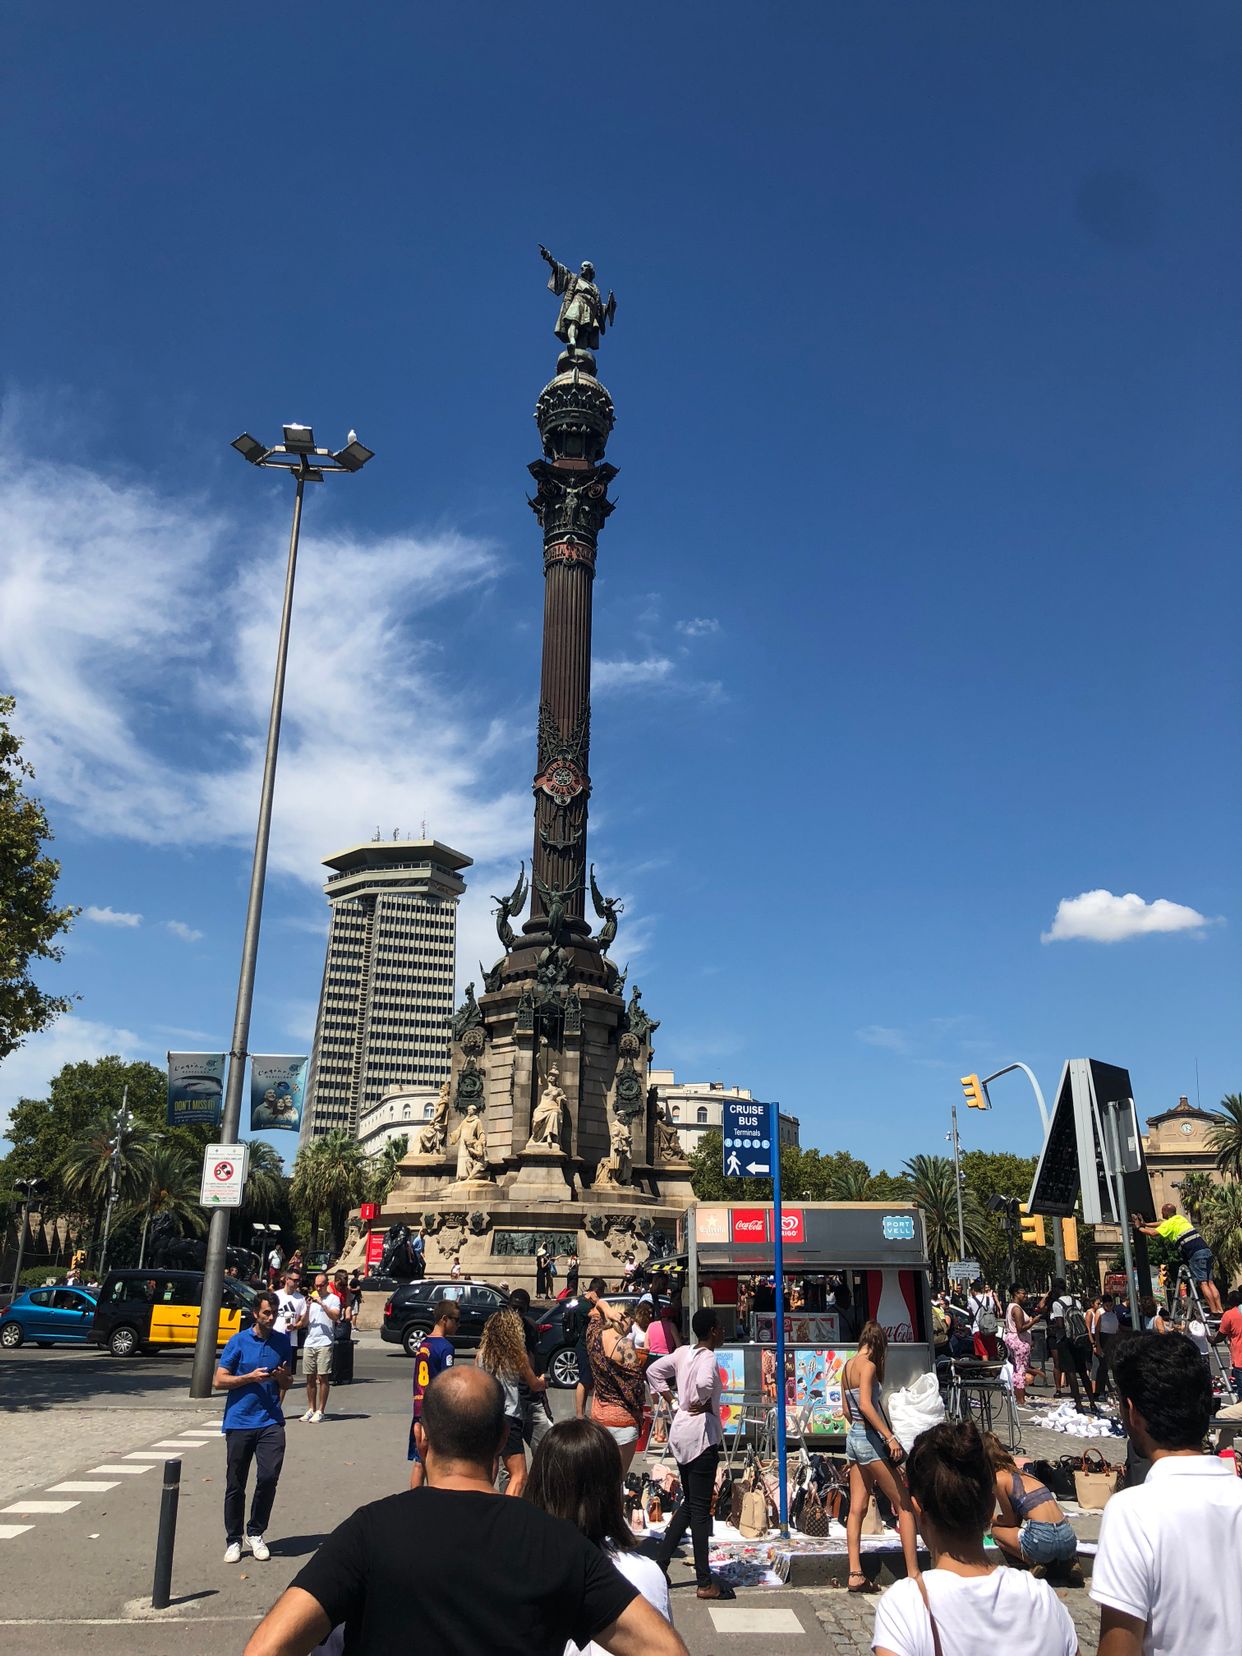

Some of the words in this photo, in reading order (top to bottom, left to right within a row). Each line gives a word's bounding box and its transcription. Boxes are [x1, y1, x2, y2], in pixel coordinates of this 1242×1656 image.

[174, 1100, 191, 1111] DON'T
[192, 1099, 207, 1110] MISS
[729, 1105, 764, 1114] CRUISE
[738, 1116, 758, 1126] BUS
[734, 1128, 760, 1136] Terminals
[418, 1361, 430, 1387] 8
